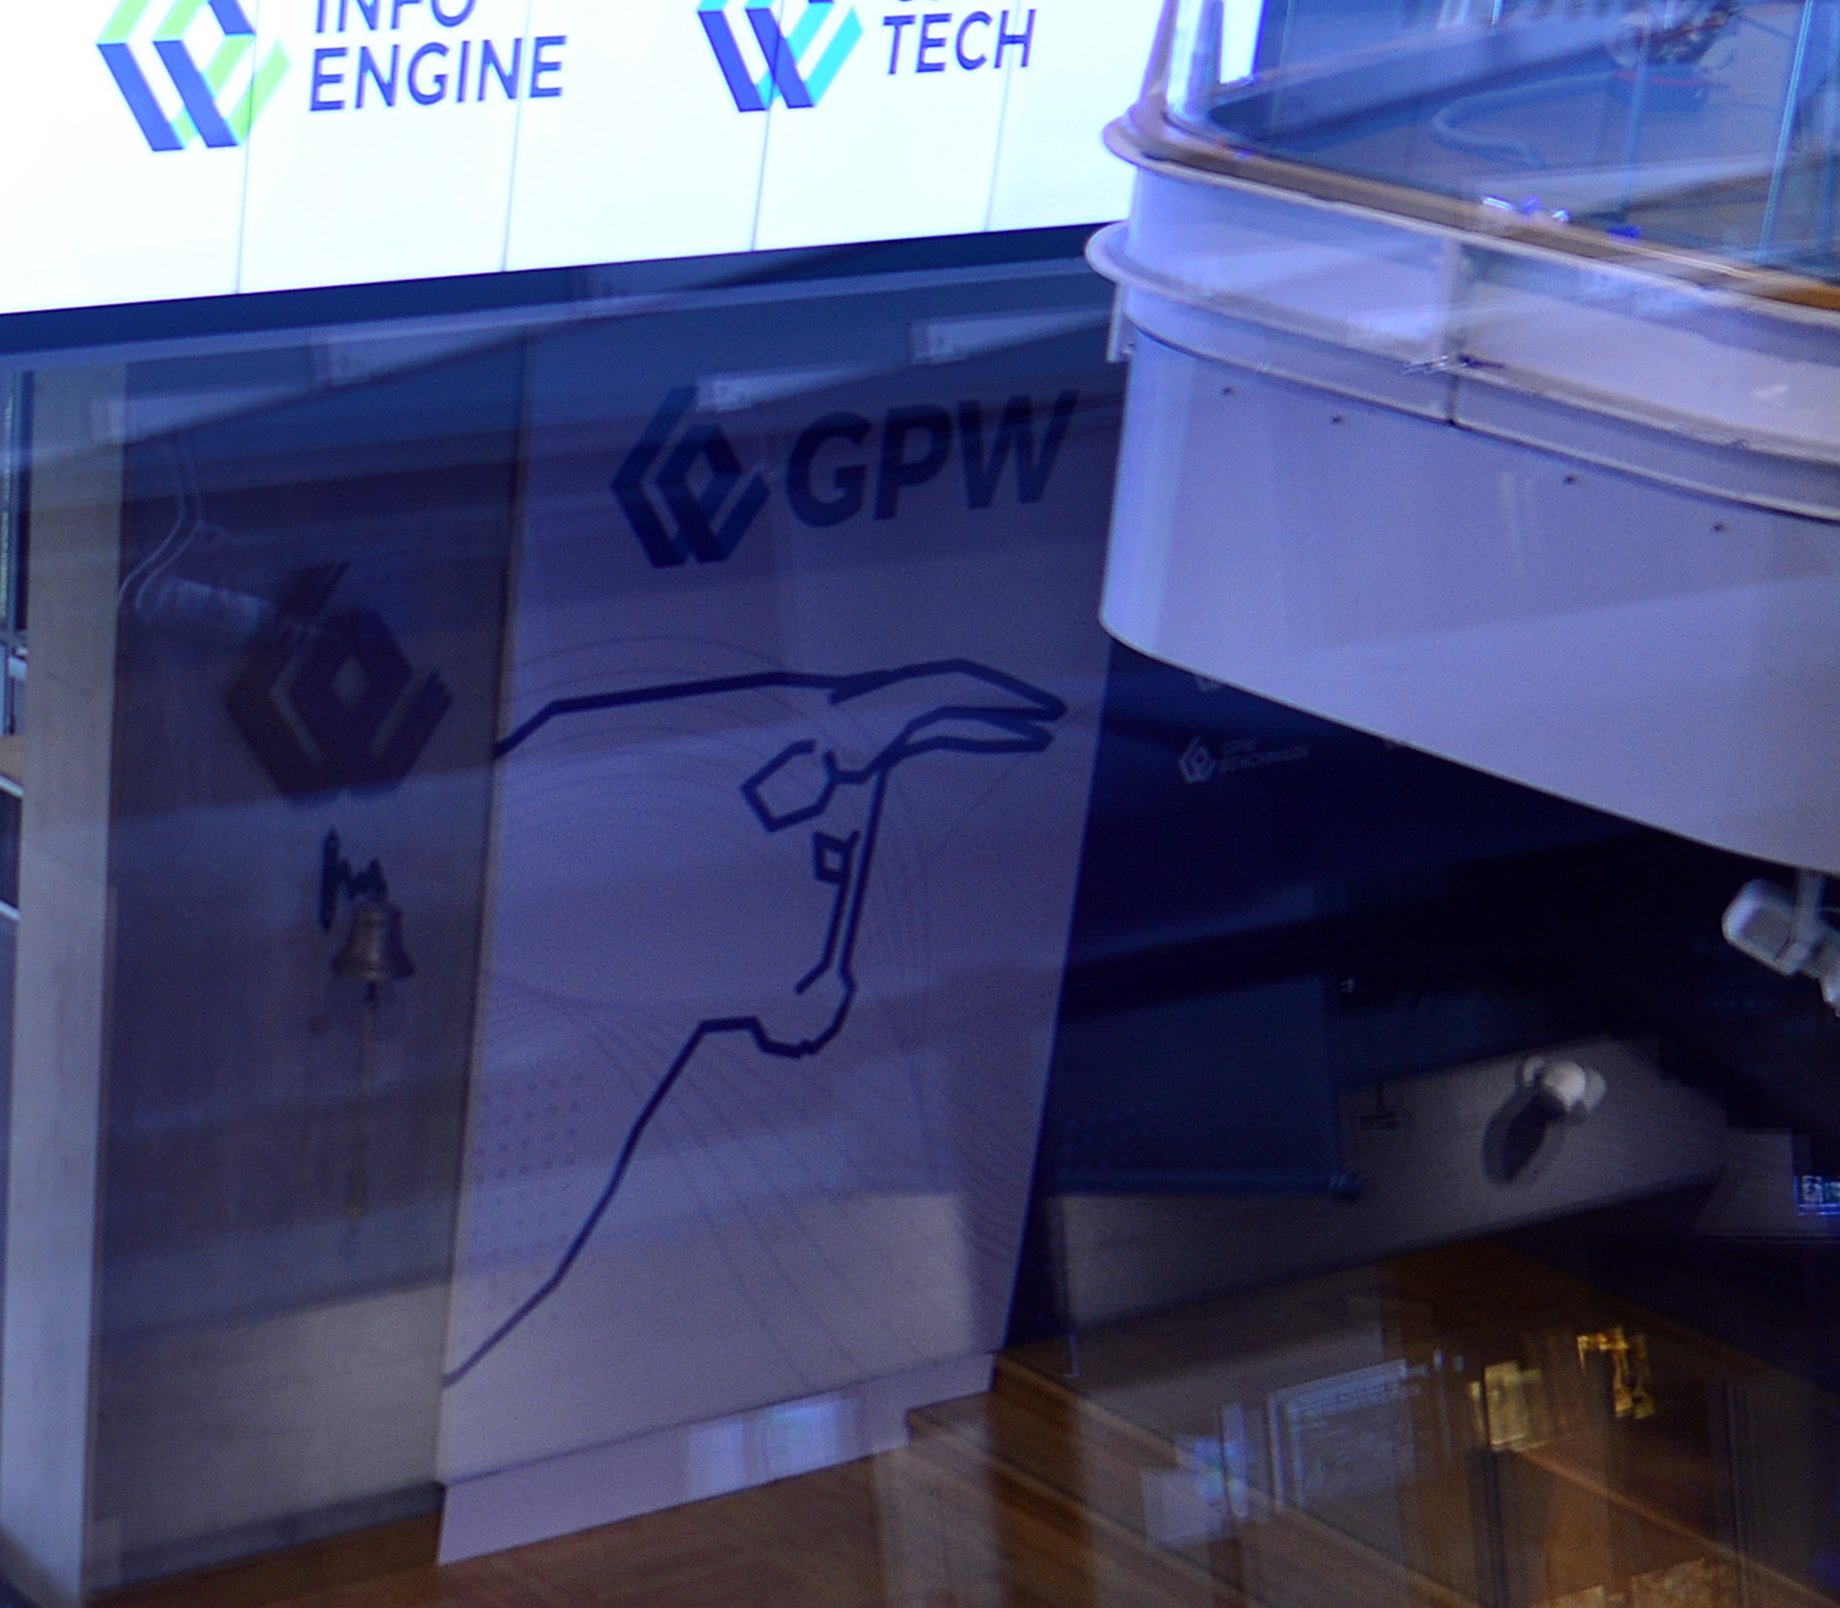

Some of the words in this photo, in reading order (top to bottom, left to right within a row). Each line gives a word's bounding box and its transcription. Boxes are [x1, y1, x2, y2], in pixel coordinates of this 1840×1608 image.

[309, 35, 567, 112] ENGINE
[882, 9, 1037, 75] TECH
[786, 389, 1081, 528] GPW
